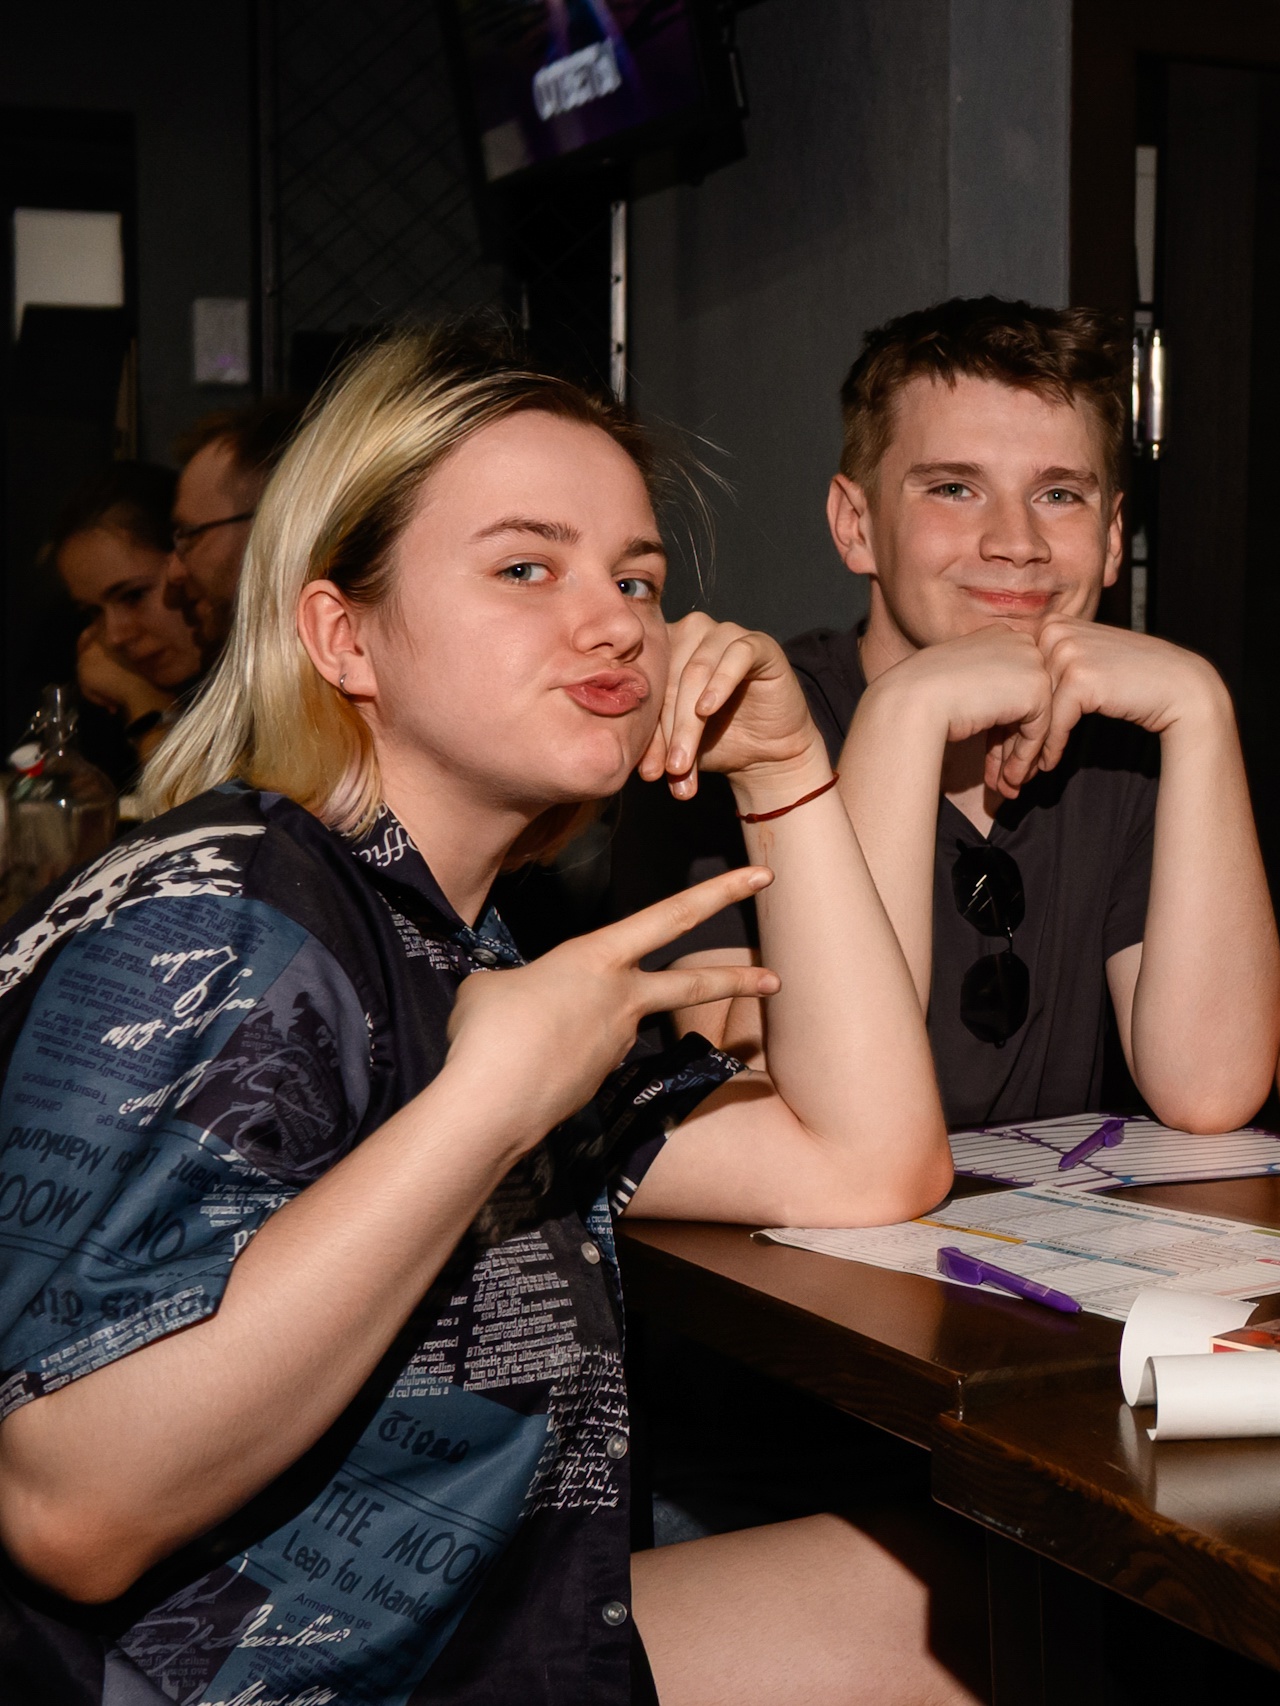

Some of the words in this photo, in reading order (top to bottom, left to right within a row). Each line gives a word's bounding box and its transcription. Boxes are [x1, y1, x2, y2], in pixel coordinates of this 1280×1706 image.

[0, 1172, 94, 1234] MOO
[312, 1481, 385, 1548] THE
[281, 1529, 332, 1582] Leap
